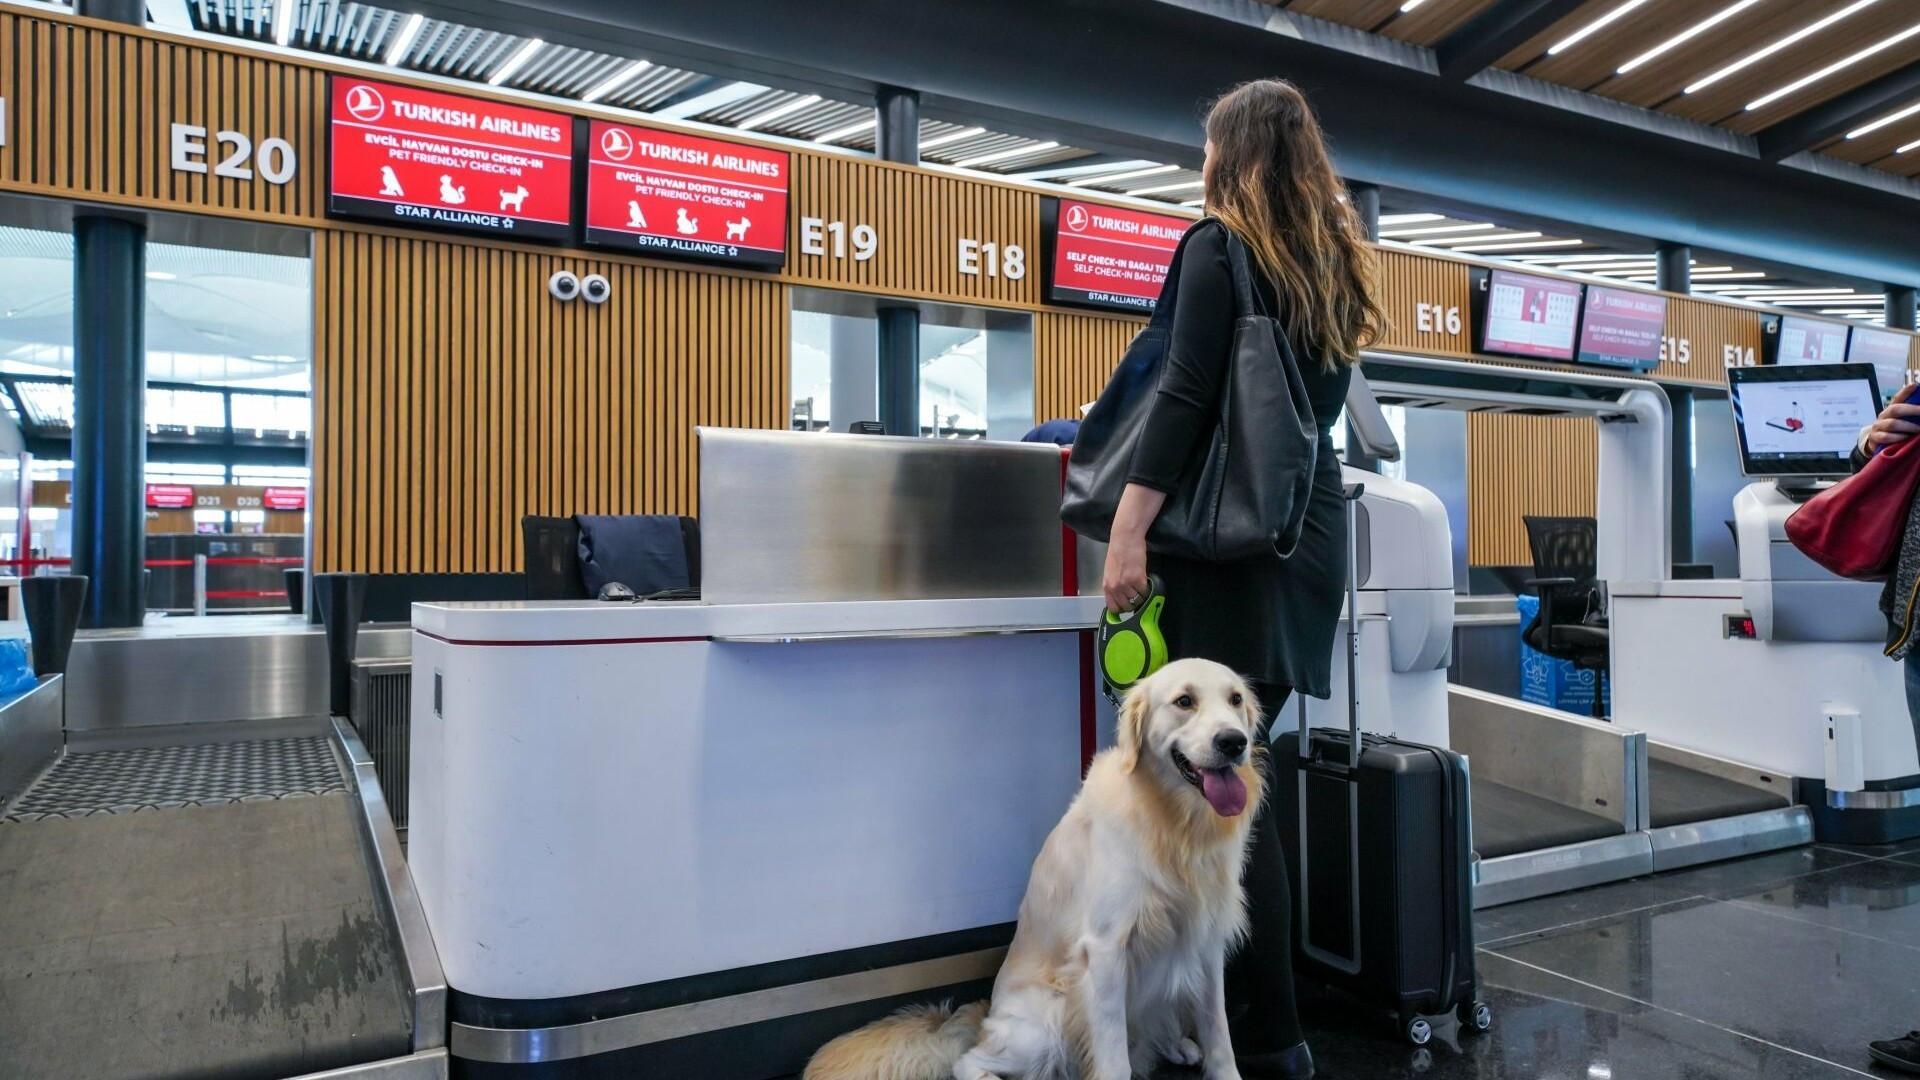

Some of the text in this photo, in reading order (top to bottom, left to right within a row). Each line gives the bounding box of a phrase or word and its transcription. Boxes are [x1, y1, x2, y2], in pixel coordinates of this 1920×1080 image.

[391, 101, 561, 142] TURKISH AIRLINES
[171, 123, 296, 184] E20
[389, 149, 521, 176] PET FRIENDLY CHECK-IN
[402, 140, 449, 154] HAYVAN
[452, 146, 489, 160] DOSTU
[491, 152, 543, 168] CHECK-IN
[639, 141, 779, 177] TURKISH AIRLINES
[635, 185, 745, 209] PET FRIENDLY CHECK-IN
[646, 177, 685, 189] HAYVAN
[688, 182, 718, 194] DOSTU
[720, 187, 763, 202] CHECK-IN
[395, 204, 499, 226] STAR ALLIANCE
[801, 216, 878, 261] E19
[1092, 215, 1186, 241] TURKISH AIRLINE
[639, 236, 726, 255] STAR ALLIANCE
[958, 238, 1025, 280] E18
[1066, 251, 1087, 262] SELF
[1088, 255, 1126, 267] CHECK-IN
[1128, 260, 1154, 272] BAGAJ
[1073, 263, 1093, 273] SELF
[1095, 266, 1133, 279] CHECK-IN
[1134, 272, 1150, 282] BAG
[1088, 292, 1147, 306] STAR ALLIANCE
[1416, 302, 1461, 336] E16
[1659, 336, 1690, 365] E15
[1724, 343, 1756, 367] E14
[197, 496, 220, 506] D21
[237, 497, 260, 506] D20
